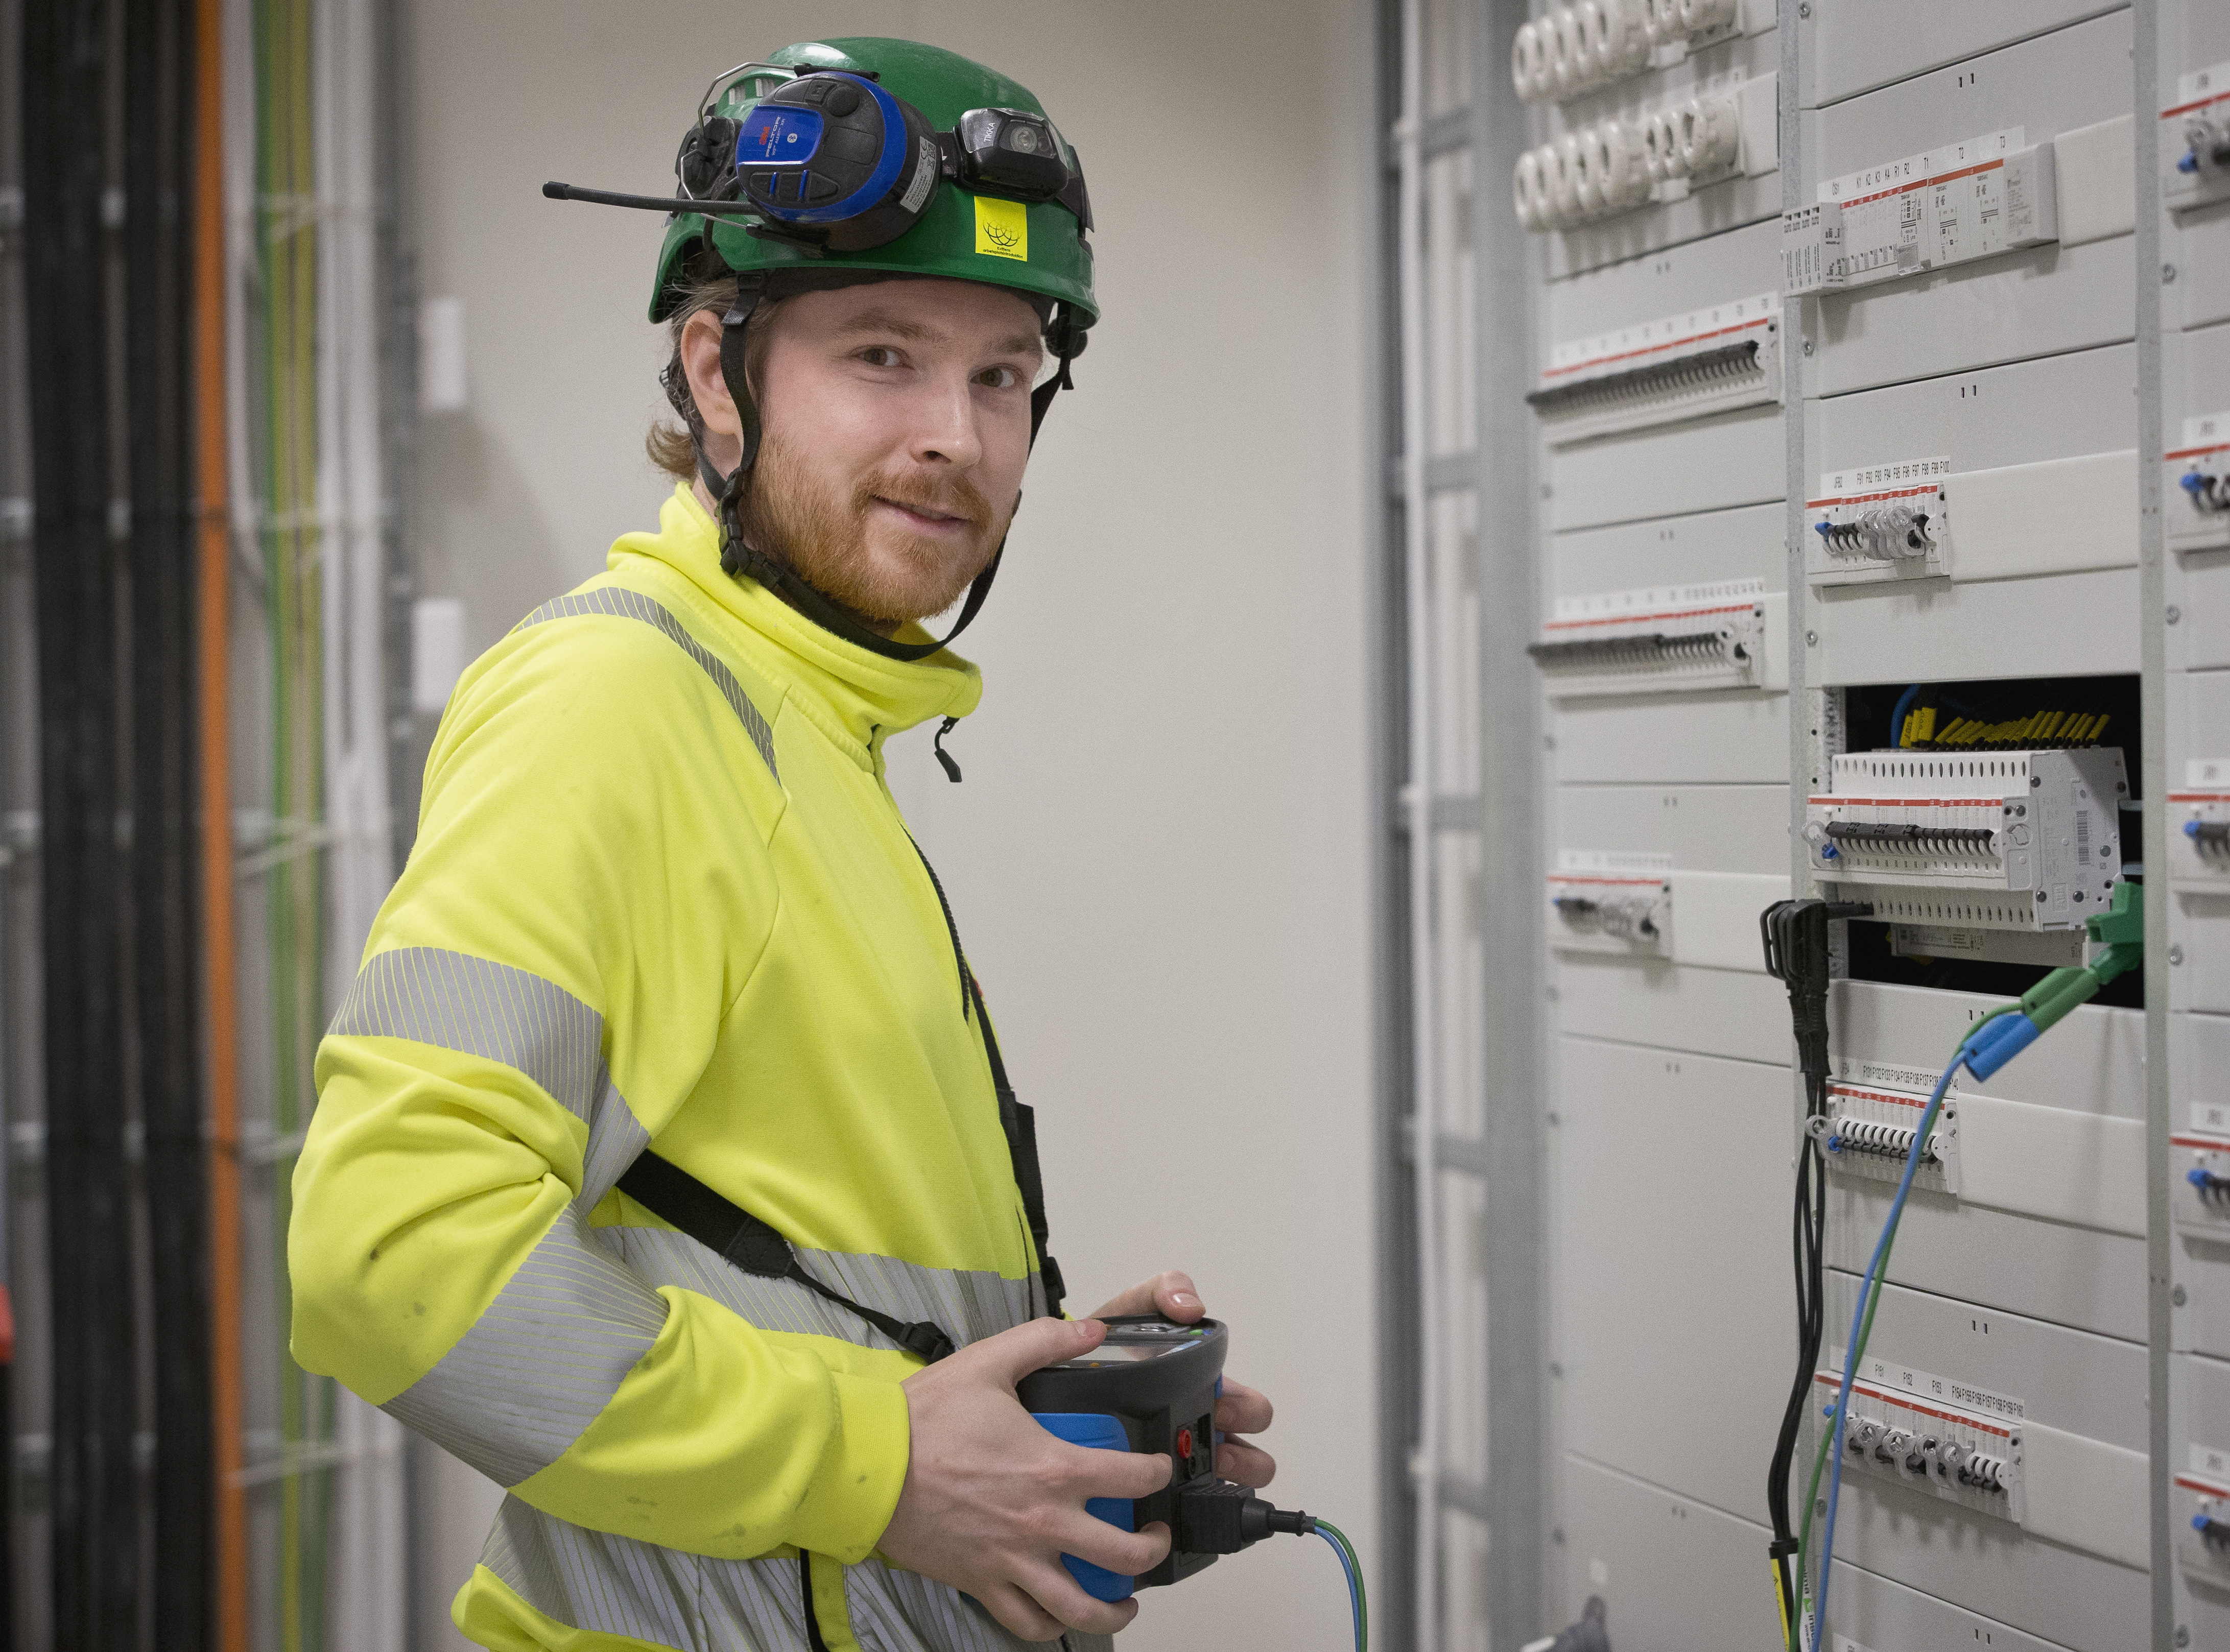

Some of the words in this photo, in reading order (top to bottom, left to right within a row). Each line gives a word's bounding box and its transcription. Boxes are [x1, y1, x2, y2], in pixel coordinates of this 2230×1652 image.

[759, 126, 770, 145] 3M
[766, 115, 781, 157] PELTOR
[984, 123, 995, 142] TIKKA
[1857, 177, 1861, 188] K1
[1866, 174, 1870, 186] K2
[1875, 171, 1880, 183] K3
[1885, 169, 1890, 180] K4
[1894, 165, 1899, 178] R1
[1904, 162, 1909, 175] R2
[1924, 157, 1929, 170] T1
[1959, 147, 1964, 159] T2
[2000, 136, 2005, 149] T3
[1940, 461, 1950, 473] F100
[1863, 1065, 1871, 1078] F131
[1872, 1067, 1881, 1080] F132
[1882, 1068, 1890, 1081] F133
[1891, 1070, 1900, 1083] F134
[1901, 1071, 1910, 1084] F135
[1910, 1072, 1919, 1085] F136
[1919, 1073, 1929, 1086] F137
[1929, 1074, 1938, 1088] F138
[1949, 1077, 1958, 1090] F140
[1875, 1364, 1884, 1377] F151
[1903, 1372, 1912, 1386] F152
[1932, 1380, 1941, 1394] F153
[1952, 1385, 1961, 1400] F154
[1962, 1388, 1972, 1403] F155
[1972, 1391, 1982, 1406] F156
[1982, 1394, 1992, 1408] F157
[1992, 1397, 2002, 1411] F158
[2003, 1400, 2013, 1415] F159
[2013, 1403, 2023, 1418] F160
